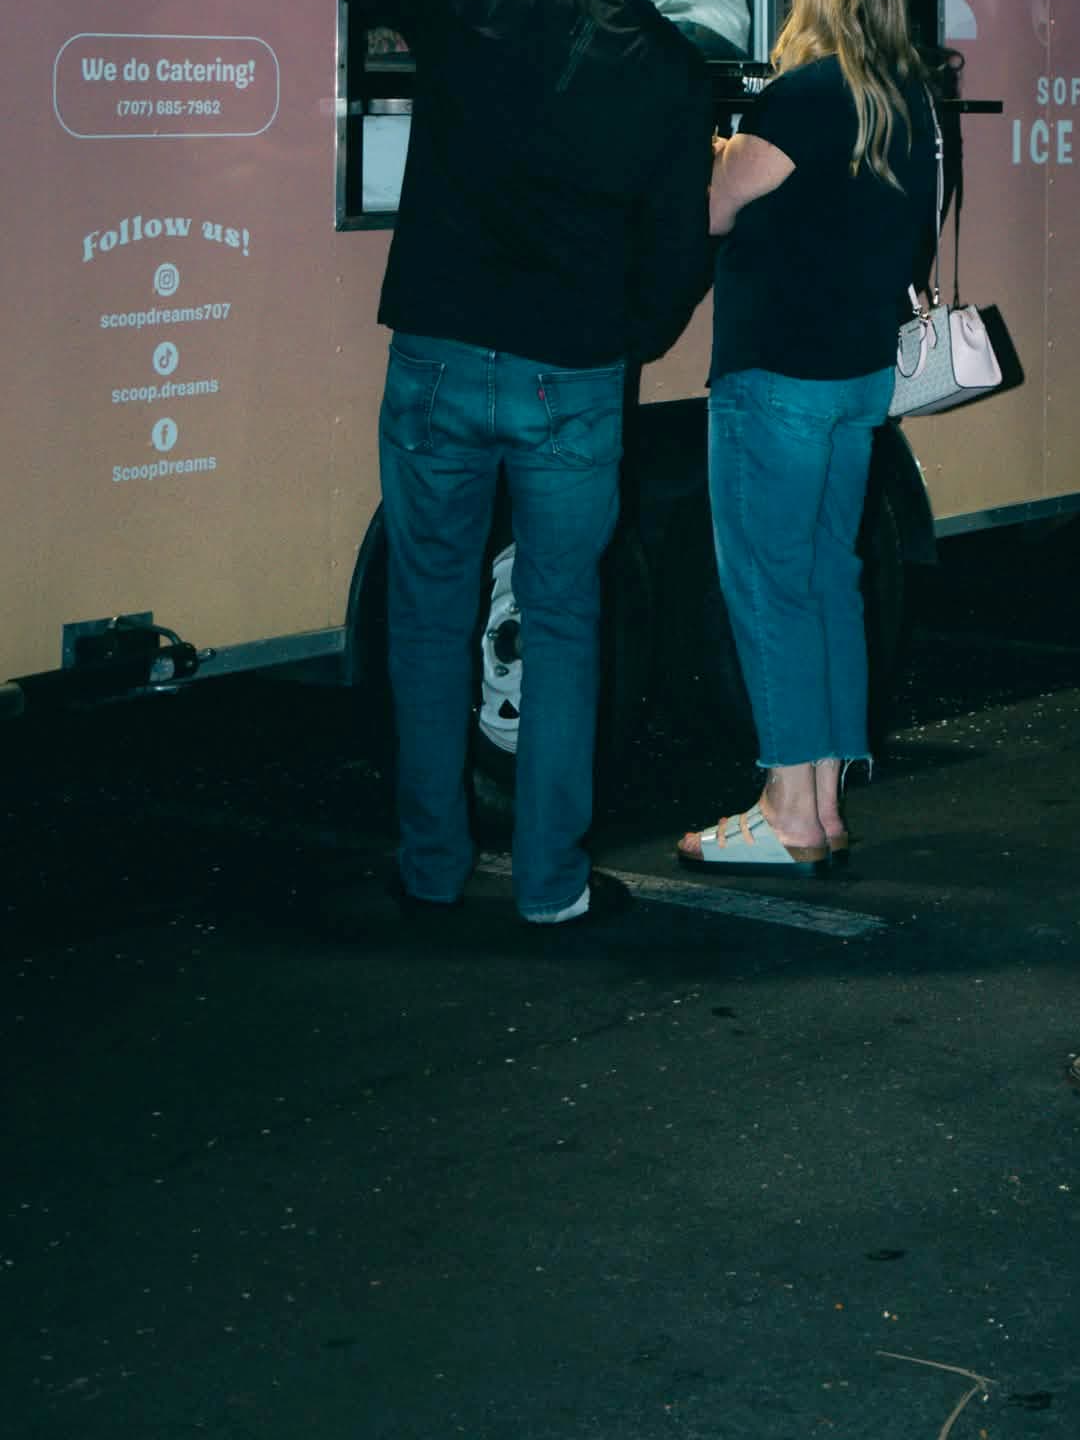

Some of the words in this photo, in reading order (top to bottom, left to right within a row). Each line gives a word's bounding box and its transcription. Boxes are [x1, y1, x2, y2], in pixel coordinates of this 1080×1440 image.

[81, 57, 117, 81] We
[123, 57, 150, 81] do
[156, 56, 257, 90] Catering!
[117, 100, 153, 116] (707)
[1012, 118, 1073, 165] ICE
[82, 215, 193, 262] Follow
[202, 220, 250, 257] us!
[100, 303, 232, 329] scoopdreams707
[112, 378, 219, 403] scoop.dreams
[112, 456, 217, 482] ScoopDreams
